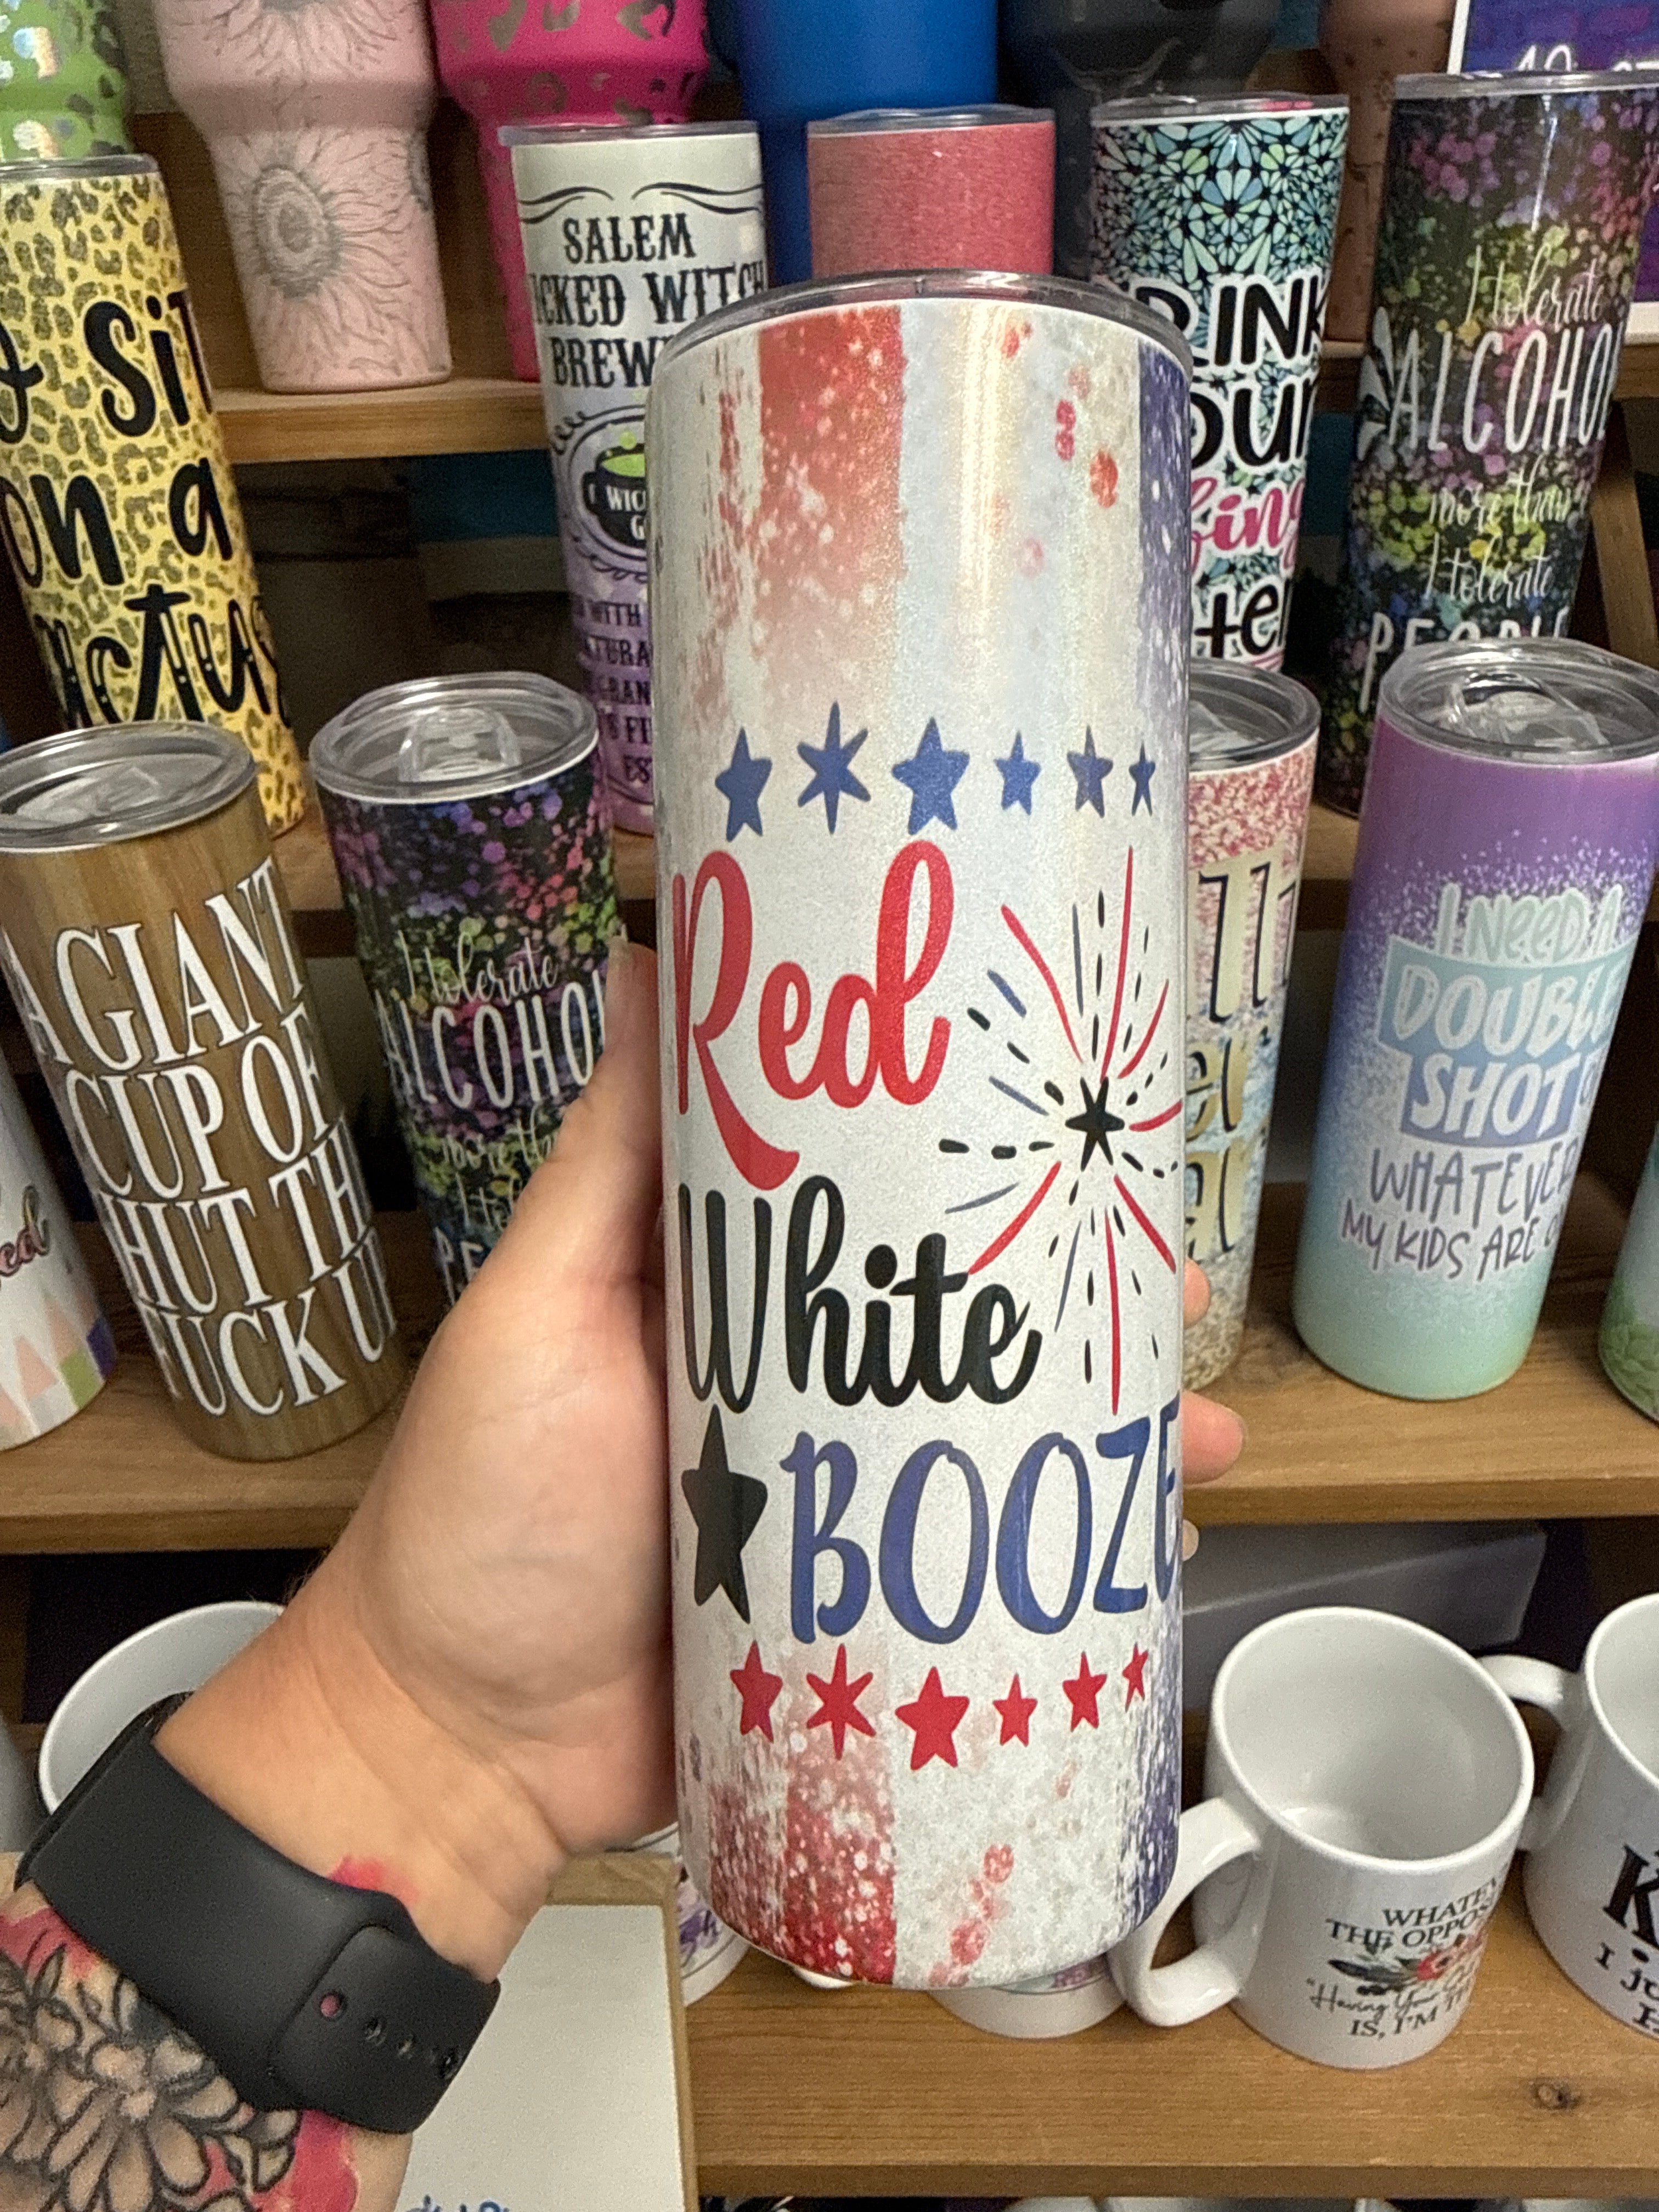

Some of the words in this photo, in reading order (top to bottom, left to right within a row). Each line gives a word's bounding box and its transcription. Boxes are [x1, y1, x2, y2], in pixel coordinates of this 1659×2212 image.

[562, 213, 697, 264] SALEM
[529, 273, 626, 328] ICKED
[550, 334, 676, 387] BREW
[57, 855, 304, 1071] GIANT
[672, 839, 955, 1191] Red
[66, 1064, 230, 1199] CUP
[241, 1002, 329, 1164] OF
[1409, 1052, 1581, 1139] SHOT
[96, 1186, 274, 1314] HUT
[679, 1175, 1042, 1414] White
[1395, 1220, 1471, 1279] KIDS
[1477, 1215, 1541, 1282] ARE
[780, 1391, 1180, 1645] BOOZE
[1381, 1876, 1498, 1927] WHATE
